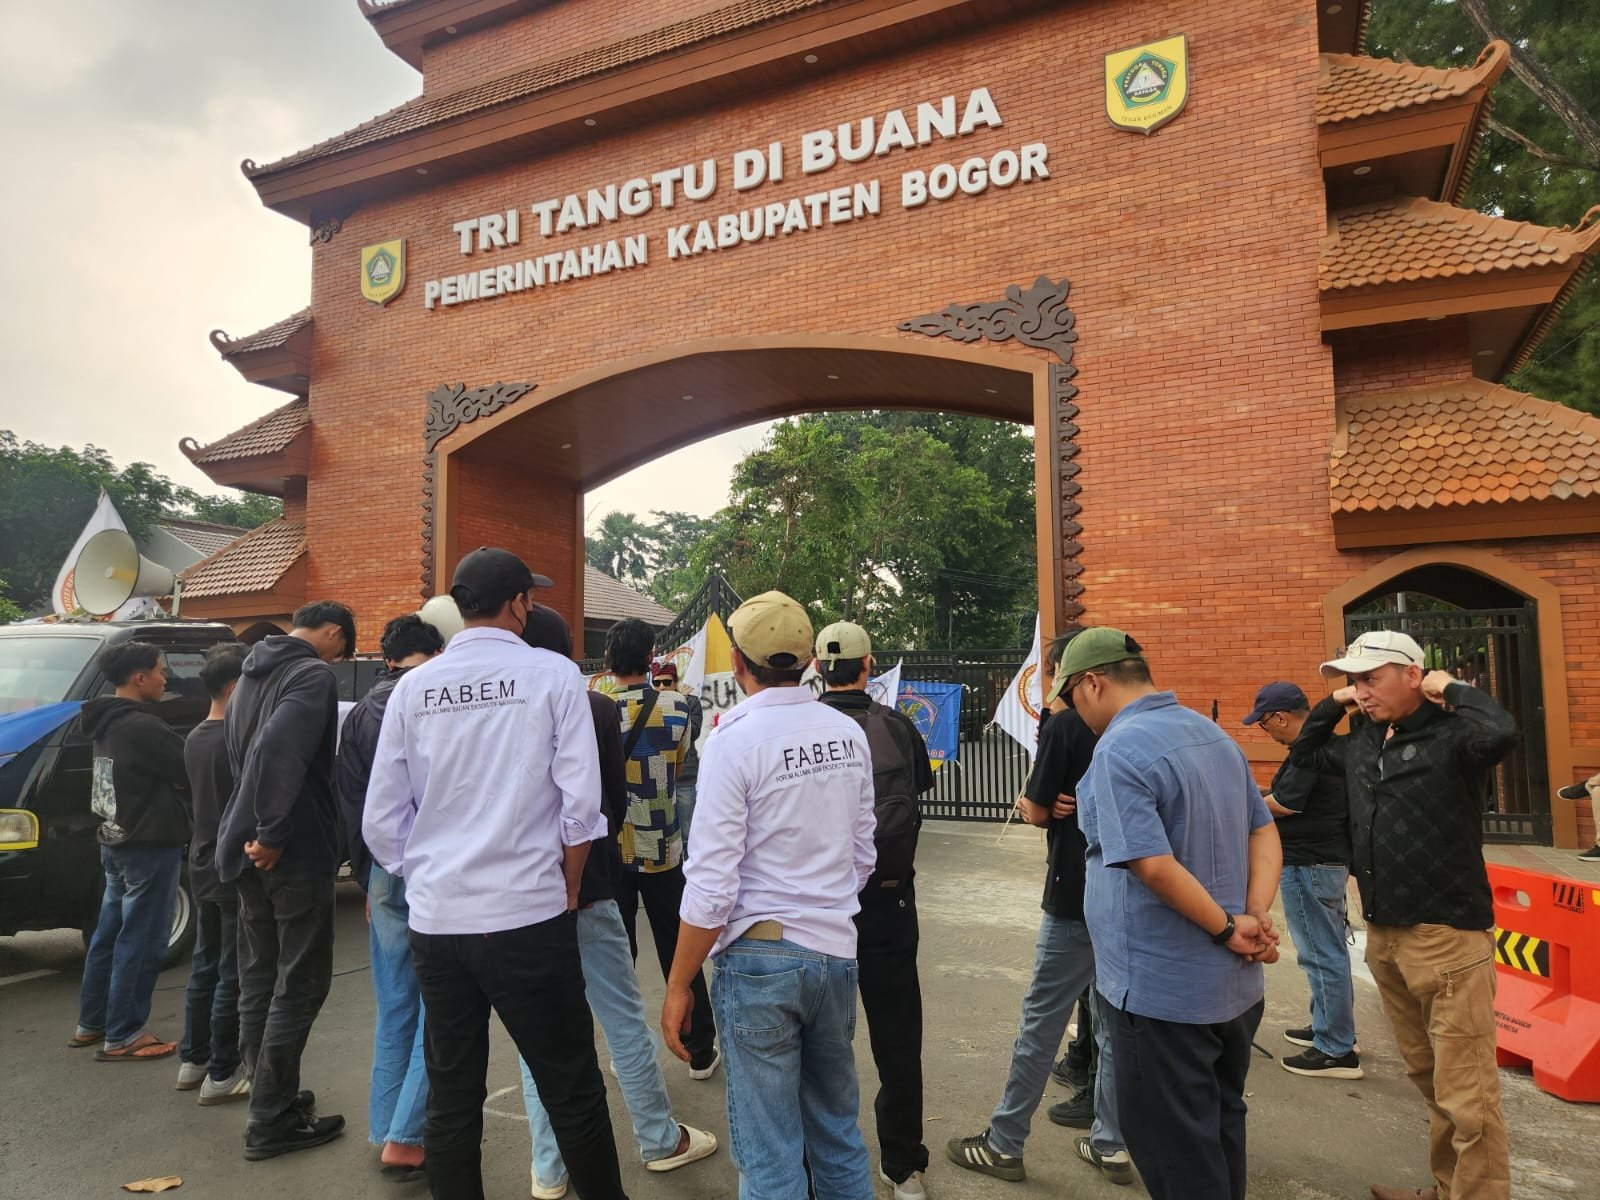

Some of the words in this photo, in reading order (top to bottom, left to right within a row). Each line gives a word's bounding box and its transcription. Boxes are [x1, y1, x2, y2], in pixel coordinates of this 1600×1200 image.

[453, 208, 520, 255] TRI
[532, 158, 717, 237] TANGTU
[733, 141, 783, 191] DI
[801, 87, 1002, 174] BUANA
[424, 233, 648, 310] PEMERINTAHAN
[667, 179, 880, 259] KABUPATEN
[902, 143, 1050, 208] BOGOR
[424, 680, 515, 708] F.A.B.E.M
[783, 739, 855, 771] F.A.B.E.M
